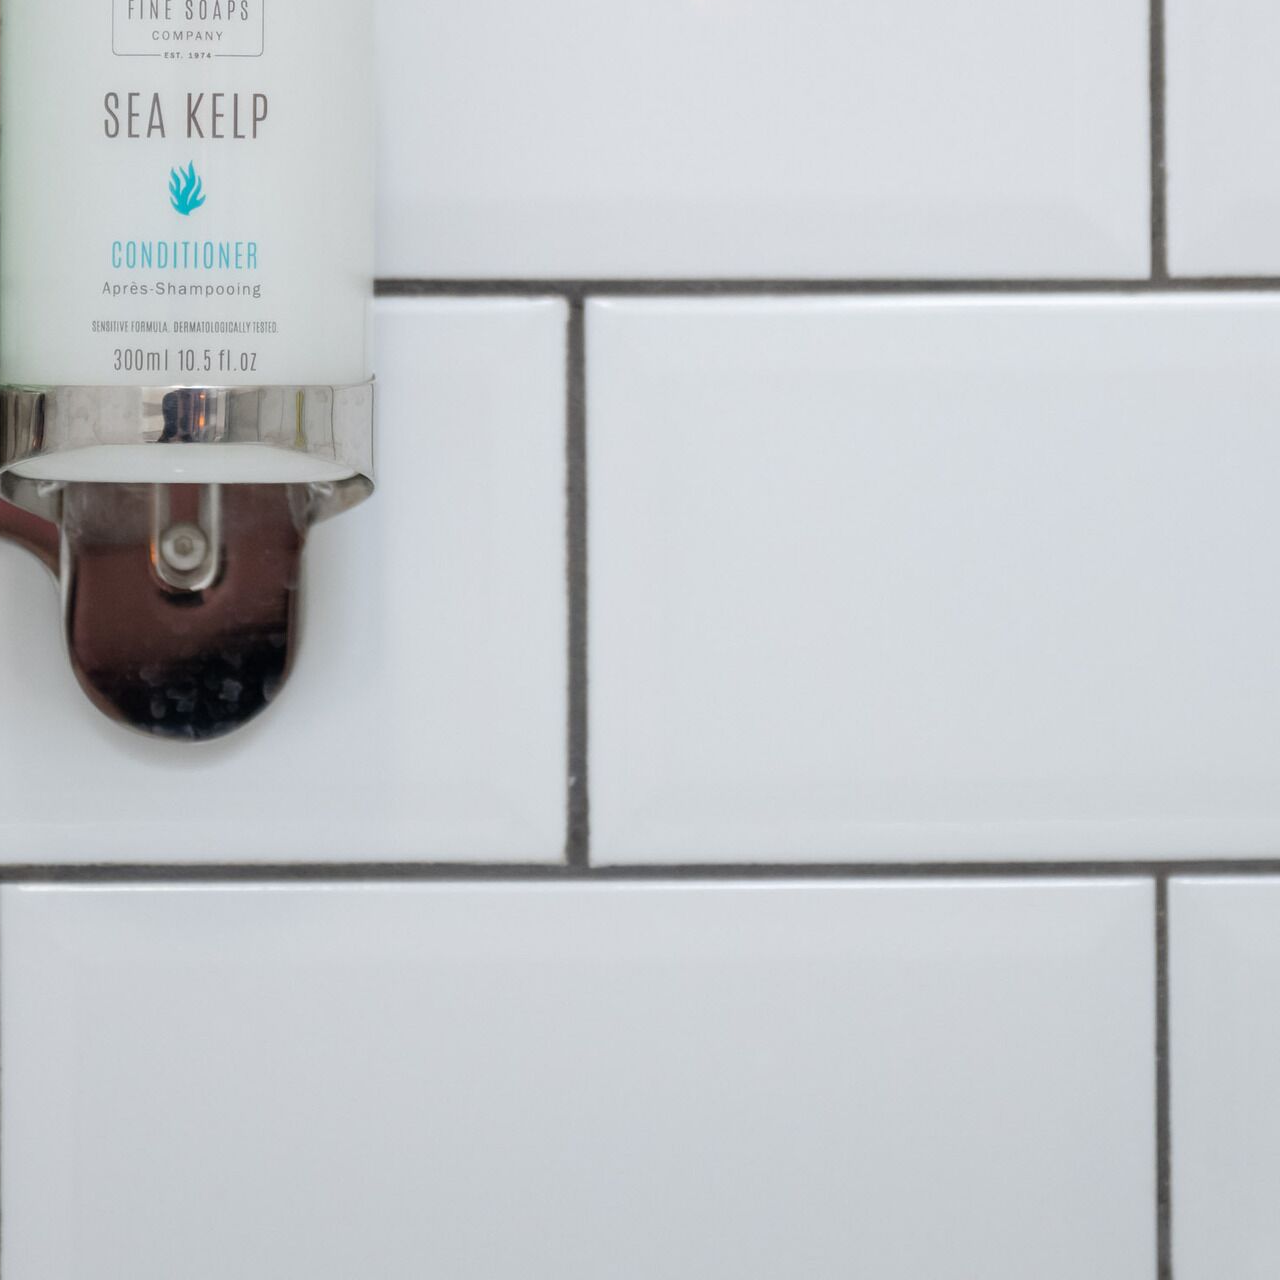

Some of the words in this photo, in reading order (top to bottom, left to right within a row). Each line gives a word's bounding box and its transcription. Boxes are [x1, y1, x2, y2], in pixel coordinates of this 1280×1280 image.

[128, 0, 173, 20] FINE
[185, 0, 249, 21] SOAPS
[151, 30, 224, 41] COMPANY
[163, 51, 184, 60] EST.
[187, 52, 212, 60] 1974
[104, 92, 166, 139] SEA
[186, 92, 269, 140] KELP
[111, 240, 258, 270] CONDITIONER
[102, 281, 262, 299] Après-Shampooing
[91, 320, 129, 333] SENSITIVE
[173, 320, 251, 334] DERMATOLOGICALLY
[113, 348, 168, 371] 300ml
[178, 349, 211, 372] 10.5
